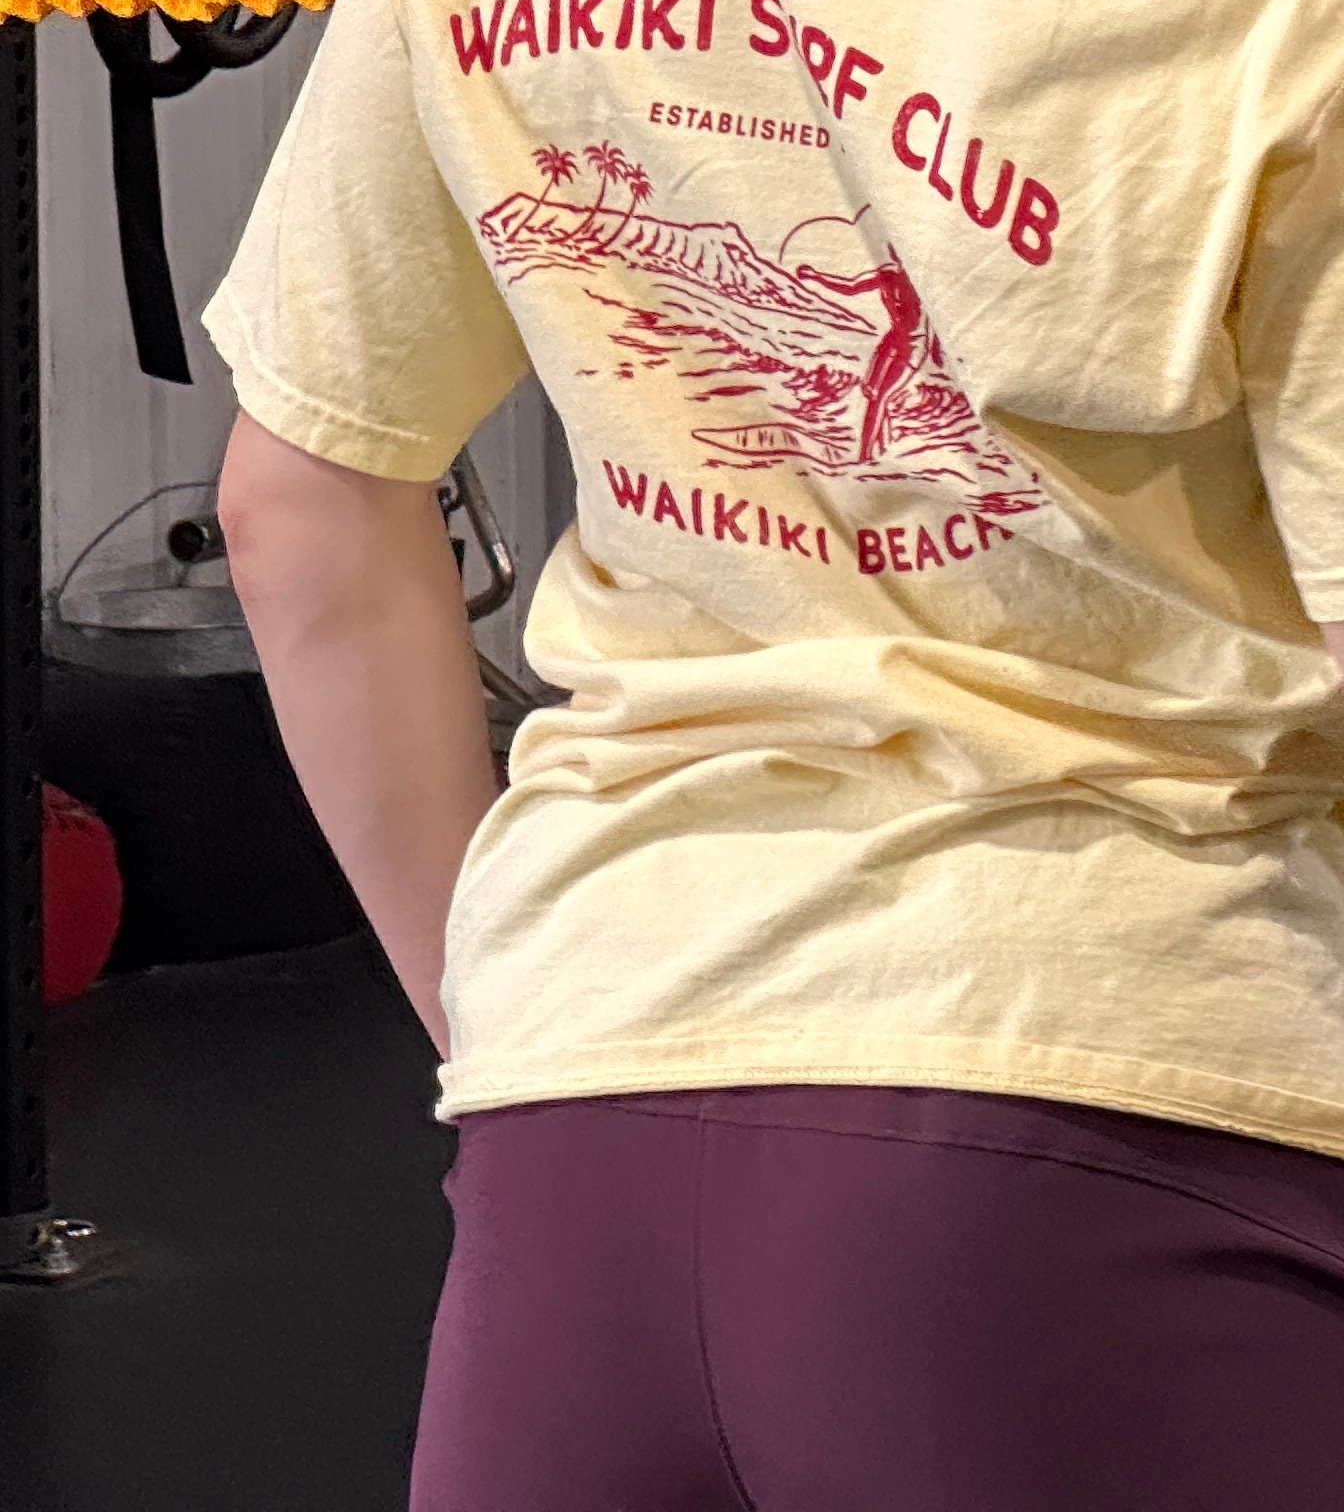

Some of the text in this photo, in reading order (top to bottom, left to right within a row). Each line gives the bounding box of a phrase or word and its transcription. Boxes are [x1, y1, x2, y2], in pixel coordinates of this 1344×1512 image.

[649, 102, 832, 149] ESTABLISHED
[891, 92, 1062, 267] CLUB
[603, 460, 831, 564] WAIKIKI
